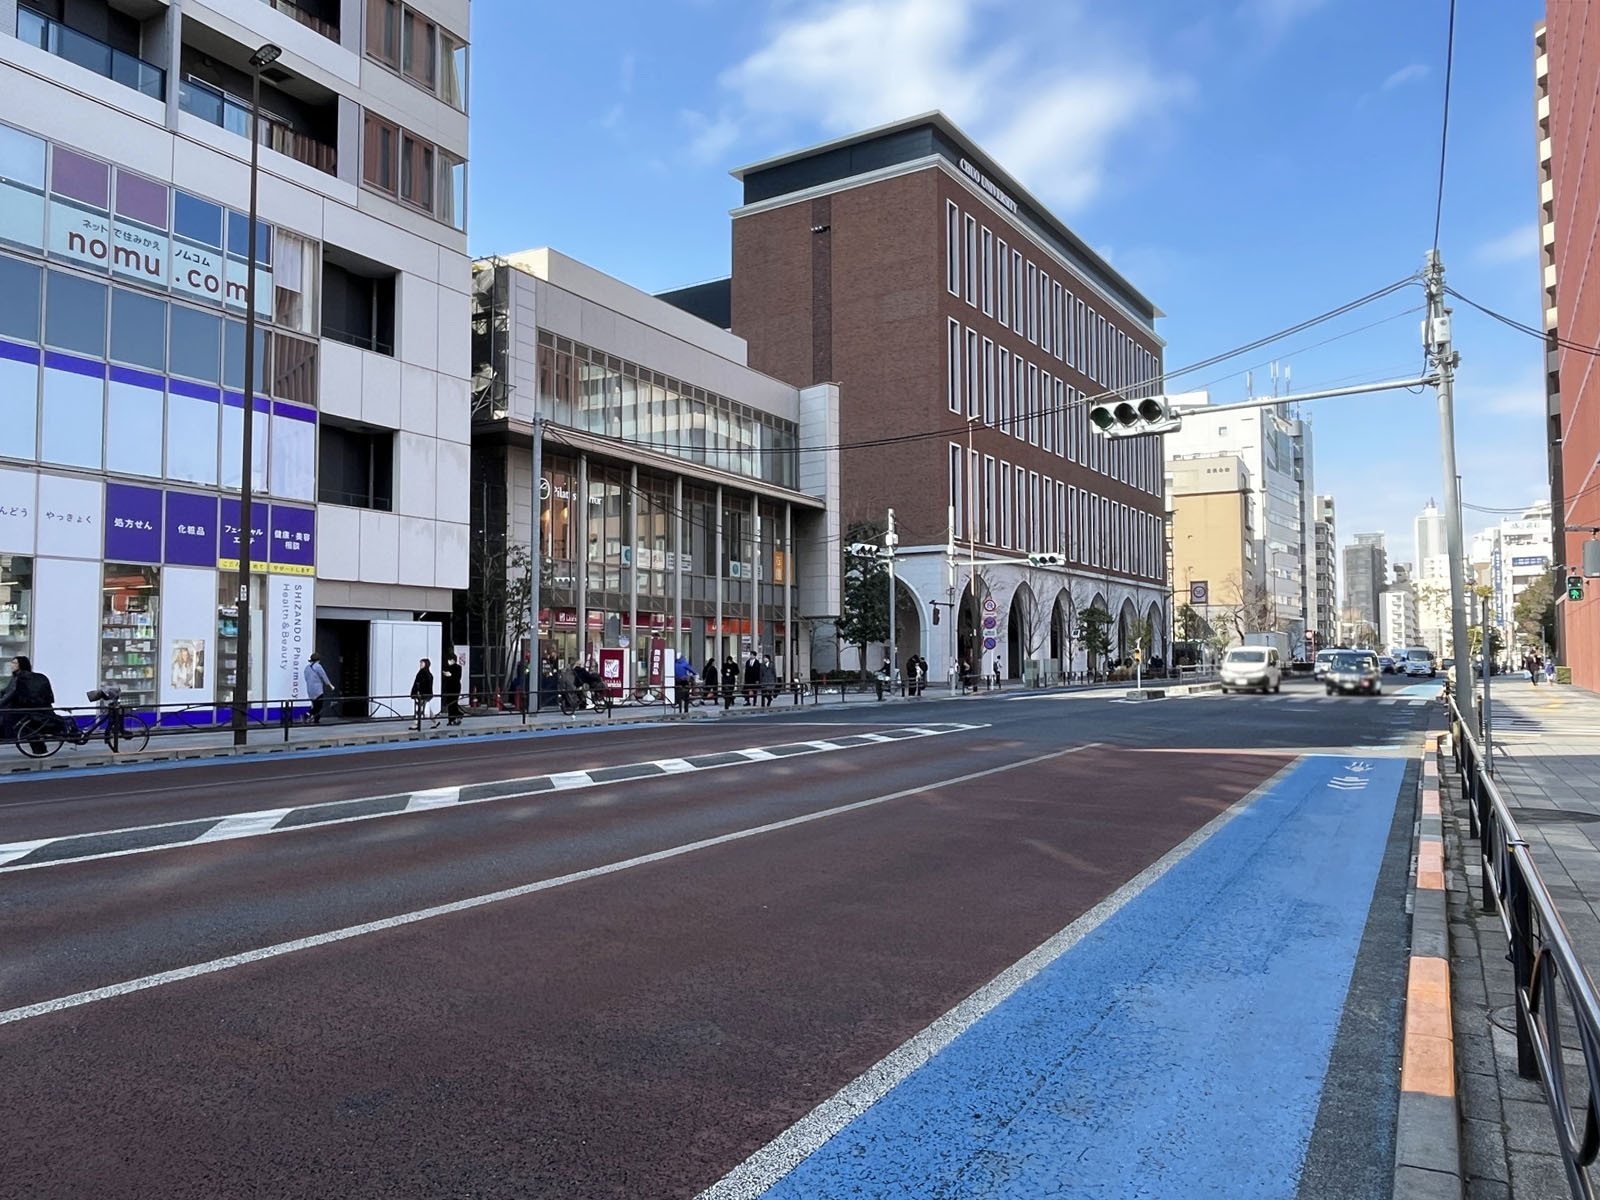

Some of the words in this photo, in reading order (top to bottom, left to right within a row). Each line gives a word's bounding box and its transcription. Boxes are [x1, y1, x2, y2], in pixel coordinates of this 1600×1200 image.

[82, 219, 161, 251] ネットで住みかえ
[174, 249, 211, 268] ノムコム
[46, 511, 92, 524] やっきょく
[113, 517, 153, 531] 処方せん
[177, 524, 206, 537] 化粧品
[281, 583, 290, 620] Health
[293, 584, 303, 643] SHIZANDO
[279, 631, 290, 671] Beauty
[291, 646, 302, 700] Pharmacy
